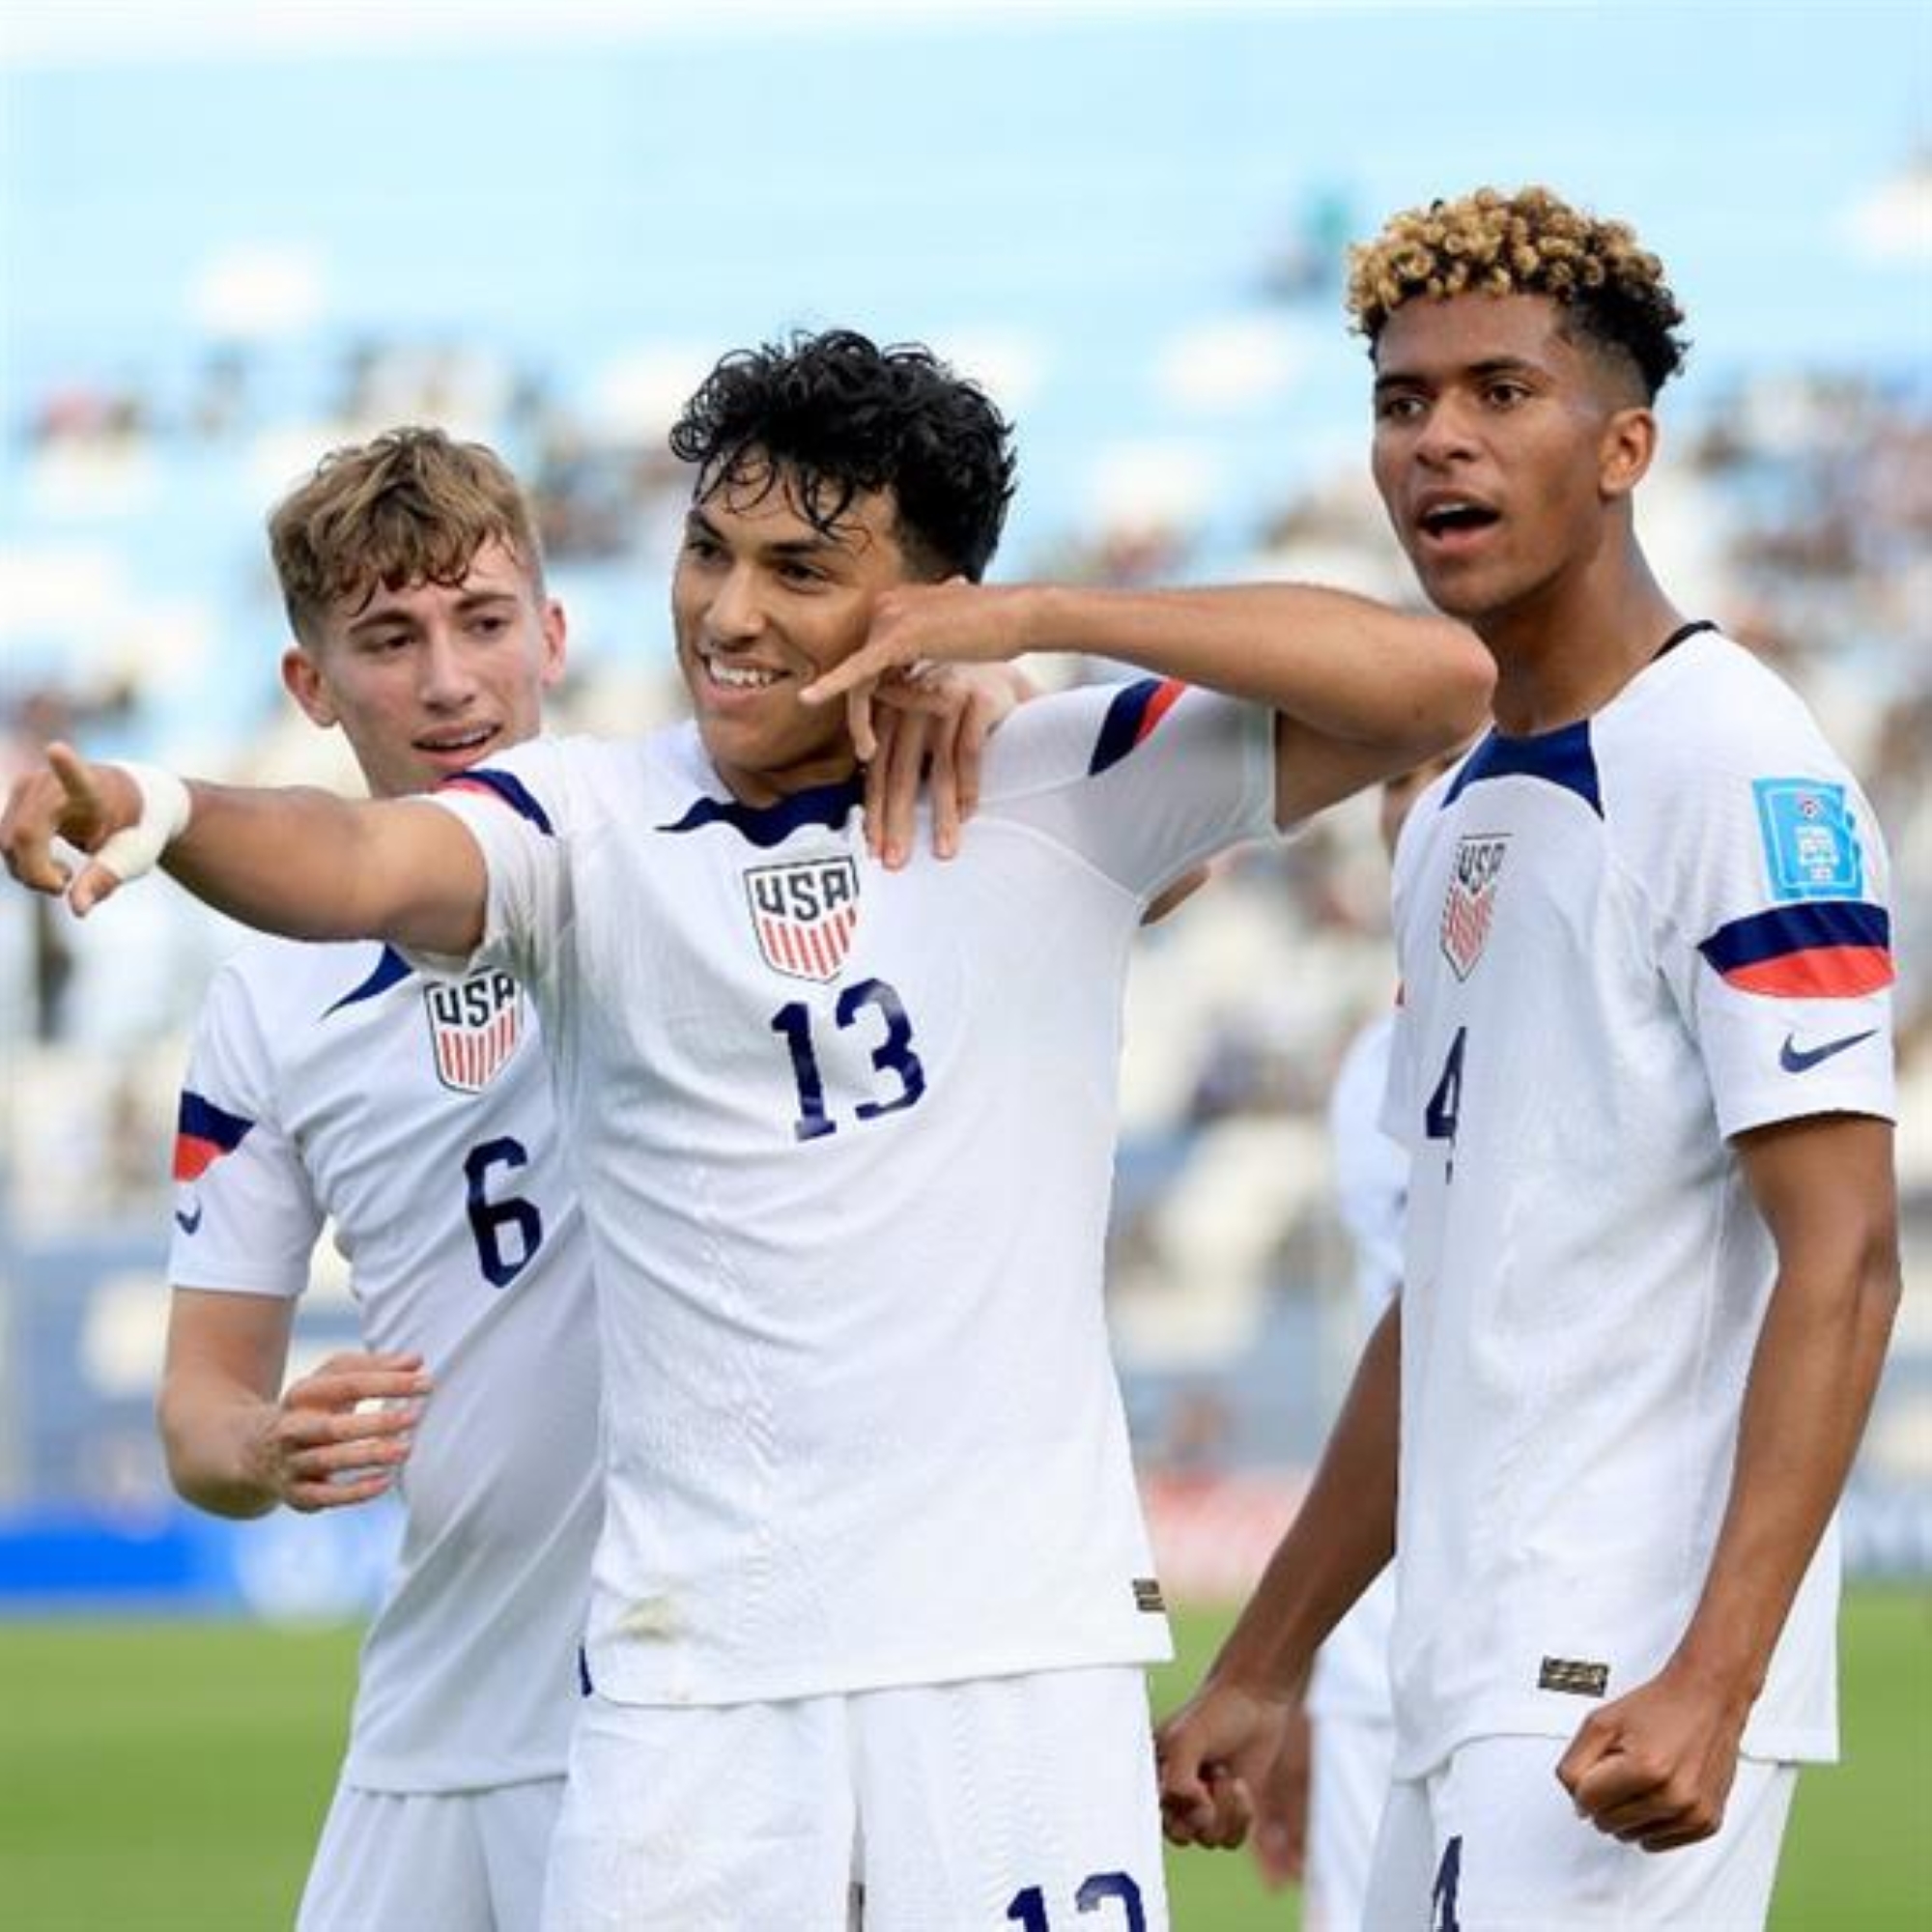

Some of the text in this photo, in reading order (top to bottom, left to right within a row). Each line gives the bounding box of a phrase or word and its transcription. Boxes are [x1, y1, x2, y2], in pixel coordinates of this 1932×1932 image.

[754, 868, 850, 922] USA
[770, 978, 927, 1143] 13
[1425, 1026, 1467, 1185] 4
[463, 1135, 543, 1289] 6
